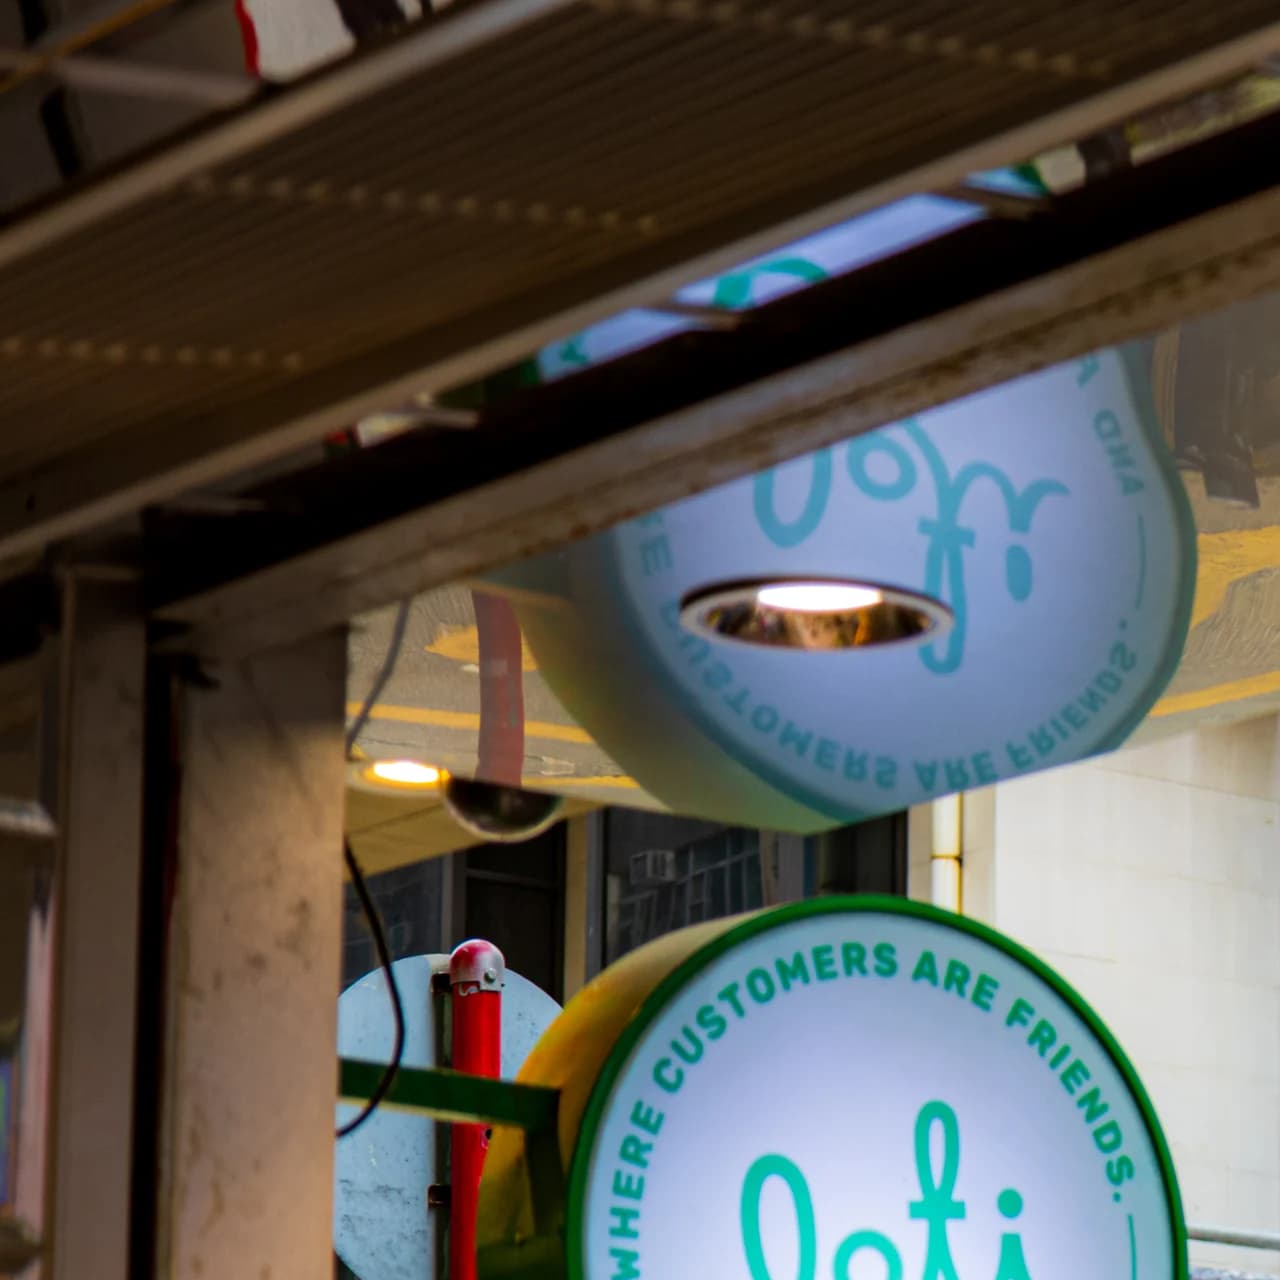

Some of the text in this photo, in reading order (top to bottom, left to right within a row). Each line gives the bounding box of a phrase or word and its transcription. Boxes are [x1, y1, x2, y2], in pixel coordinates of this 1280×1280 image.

[652, 941, 898, 1093] CUSTOMERS
[911, 950, 999, 1012] ARE
[1005, 999, 1136, 1204] FRIENDS.
